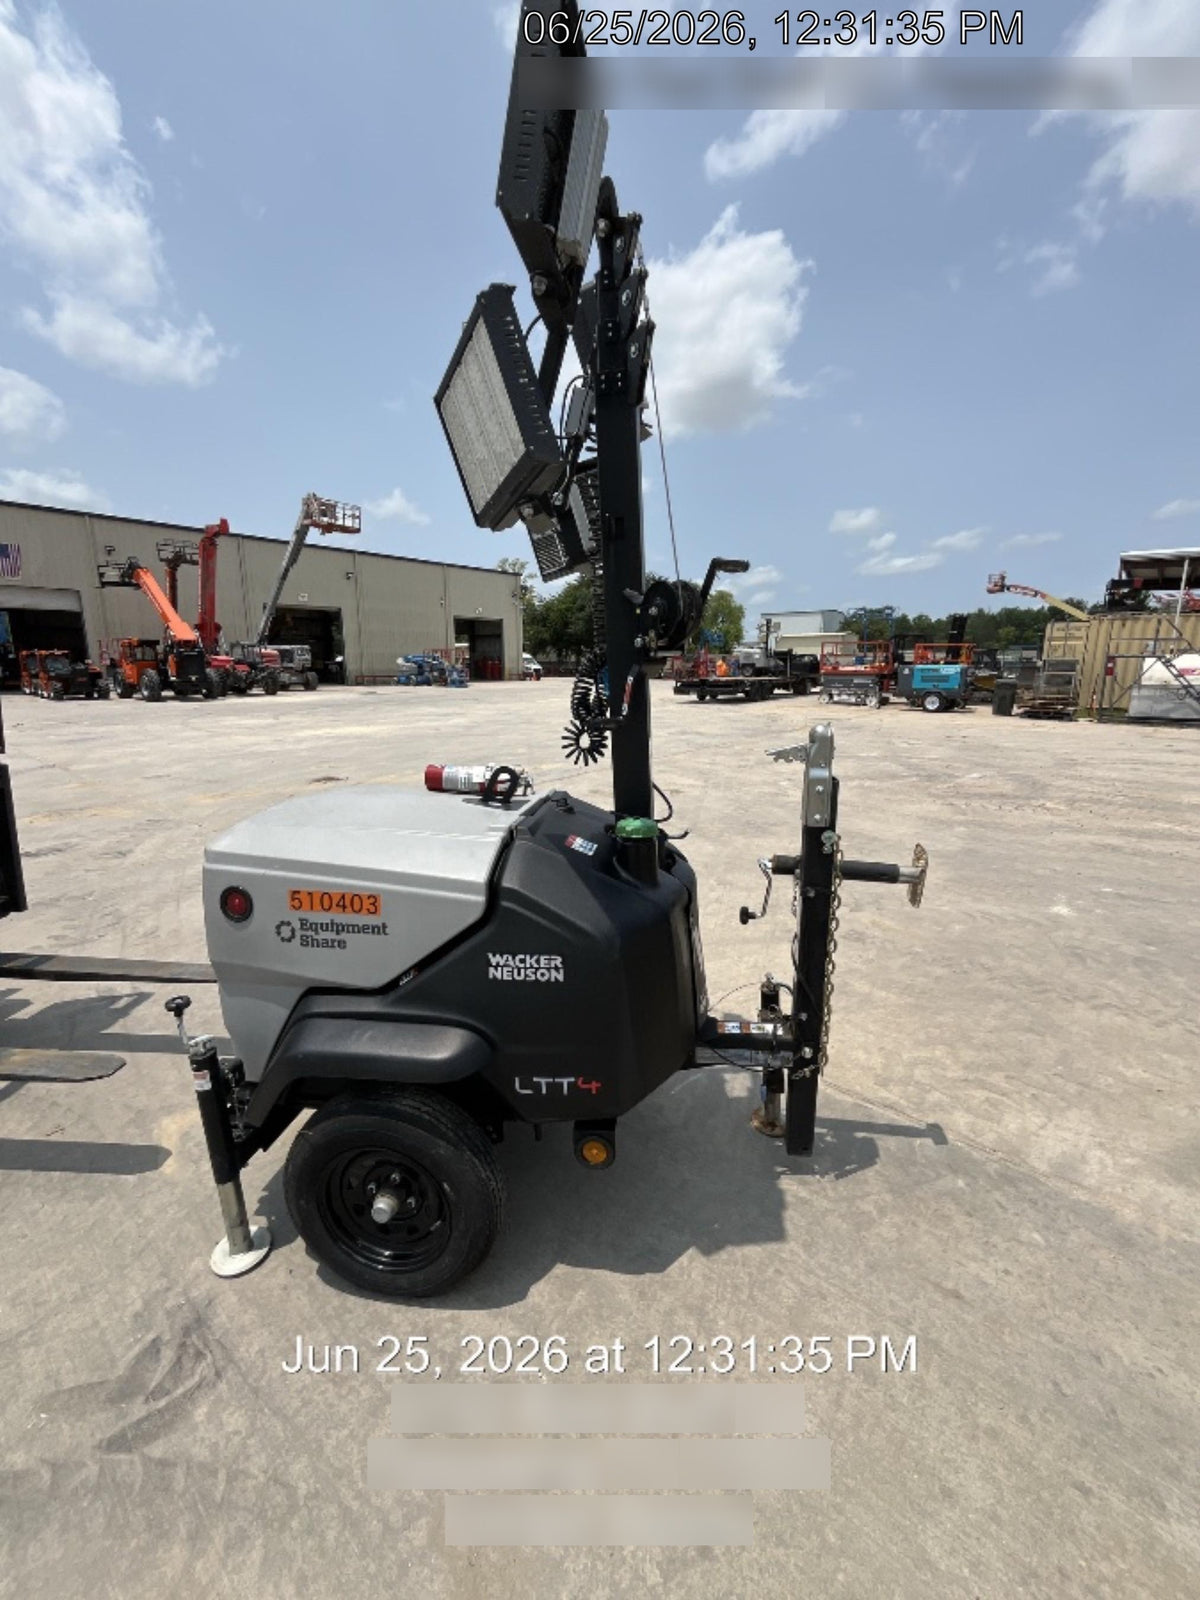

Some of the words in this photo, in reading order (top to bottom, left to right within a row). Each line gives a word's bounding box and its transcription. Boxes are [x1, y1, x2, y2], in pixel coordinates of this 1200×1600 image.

[290, 890, 378, 915] 510403
[298, 917, 389, 936] Equipment
[300, 934, 347, 950] Share
[487, 952, 564, 968] WACKER
[488, 966, 565, 982] NEUSON
[514, 1075, 602, 1096] LTT4
